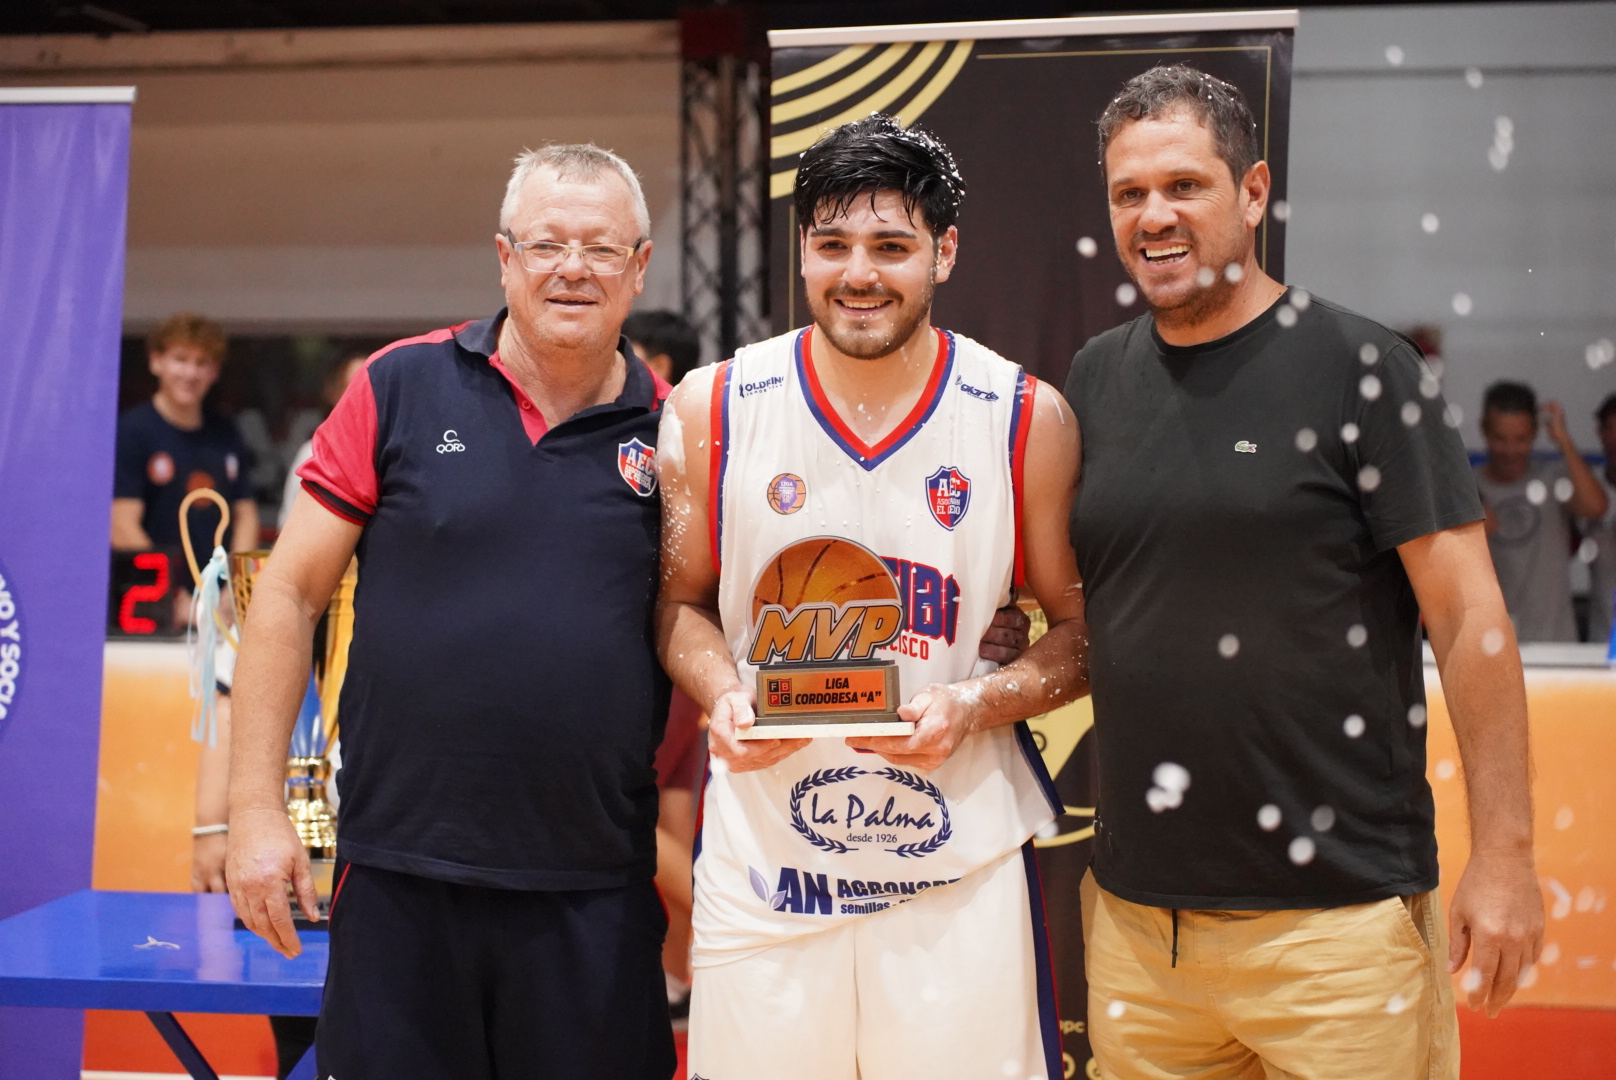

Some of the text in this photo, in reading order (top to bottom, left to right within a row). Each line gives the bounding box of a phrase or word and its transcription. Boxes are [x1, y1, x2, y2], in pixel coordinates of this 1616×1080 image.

[936, 505, 946, 515] EL
[119, 553, 170, 635] 2
[749, 604, 902, 664] MVP
[825, 677, 850, 690] LIGA
[795, 692, 859, 706] CORDOBESA
[811, 792, 935, 829] La Palma
[846, 833, 898, 843] desde 1926
[774, 866, 833, 916] AN
[840, 900, 890, 915] semillas
